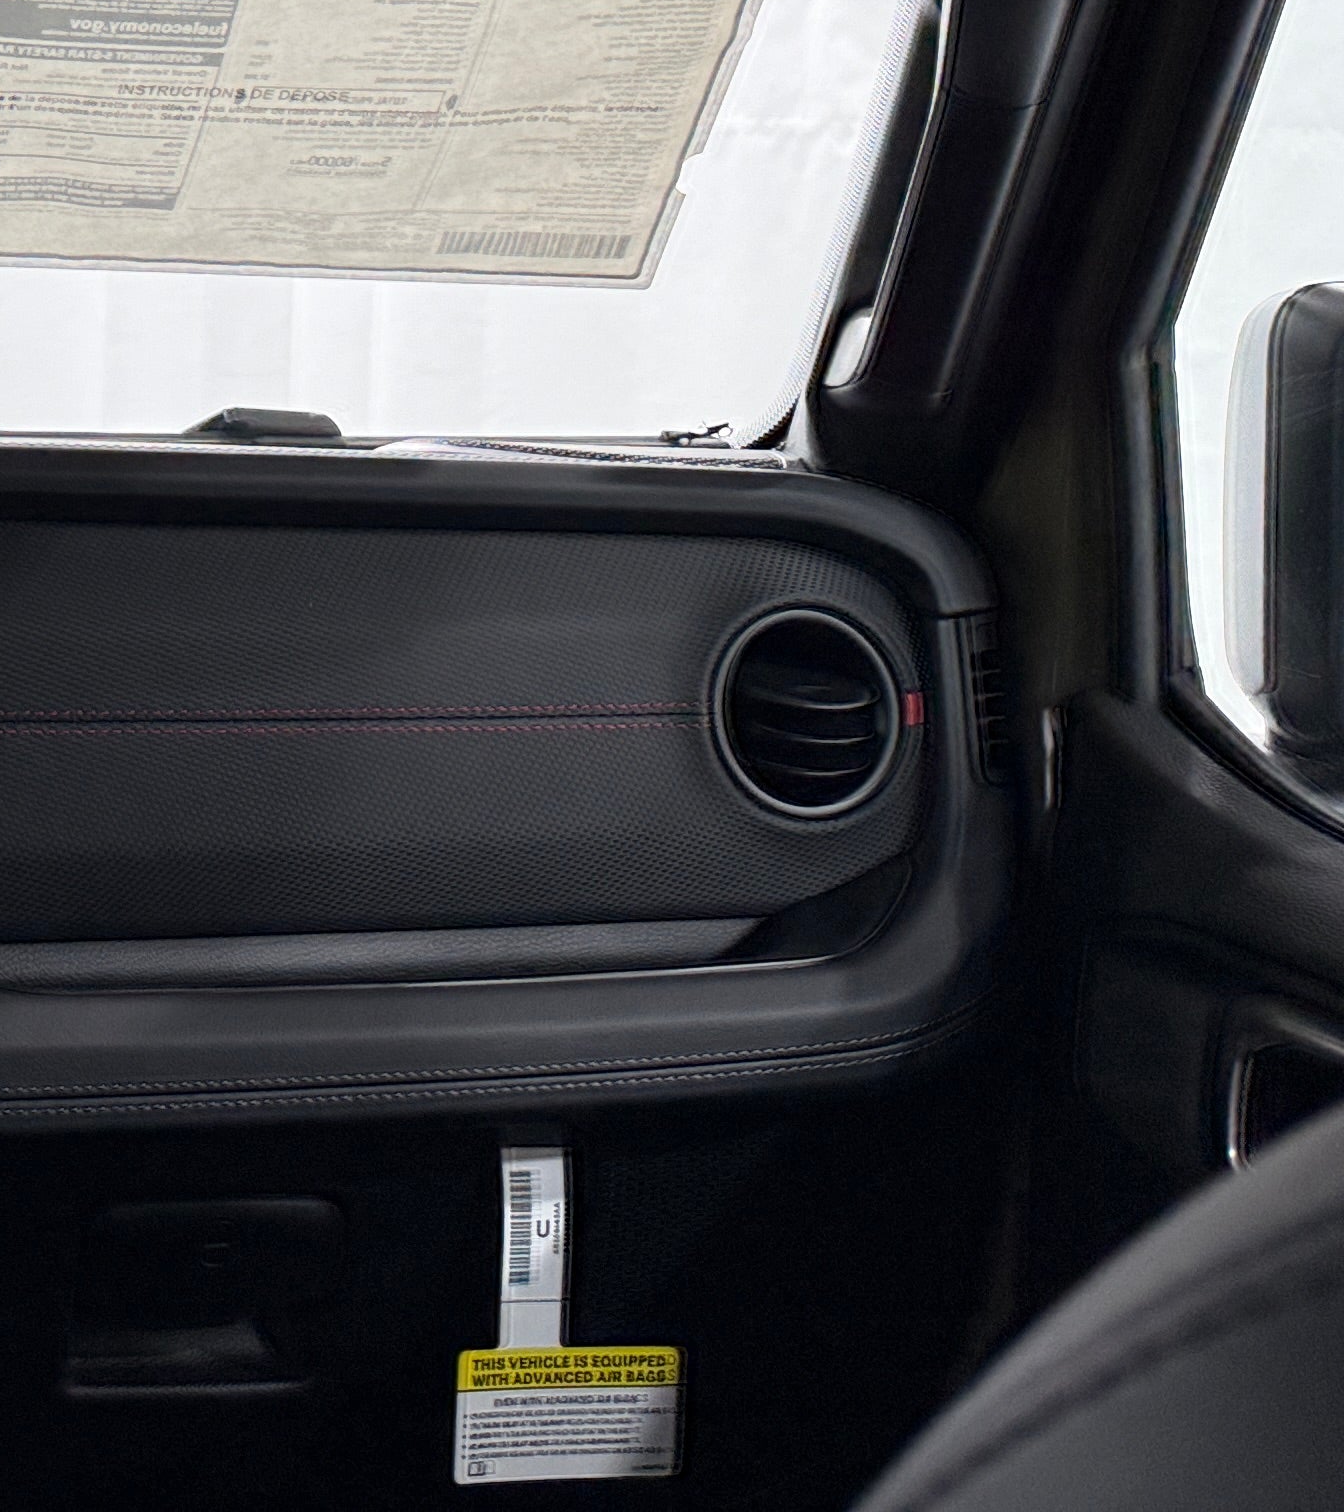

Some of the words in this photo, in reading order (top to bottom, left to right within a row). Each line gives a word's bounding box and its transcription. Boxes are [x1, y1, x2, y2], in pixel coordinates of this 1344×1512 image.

[118, 83, 248, 102] INSTRUCTIONS
[250, 87, 274, 101] DE
[473, 1357, 506, 1371] THIS
[509, 1355, 571, 1370] VEHICLE
[574, 1354, 588, 1368] IS
[591, 1354, 669, 1368] EQUIPPED
[473, 1372, 509, 1387] WITH
[513, 1371, 593, 1385] ADVANCED
[597, 1370, 623, 1383] AIR
[626, 1369, 669, 1383] BAGS
